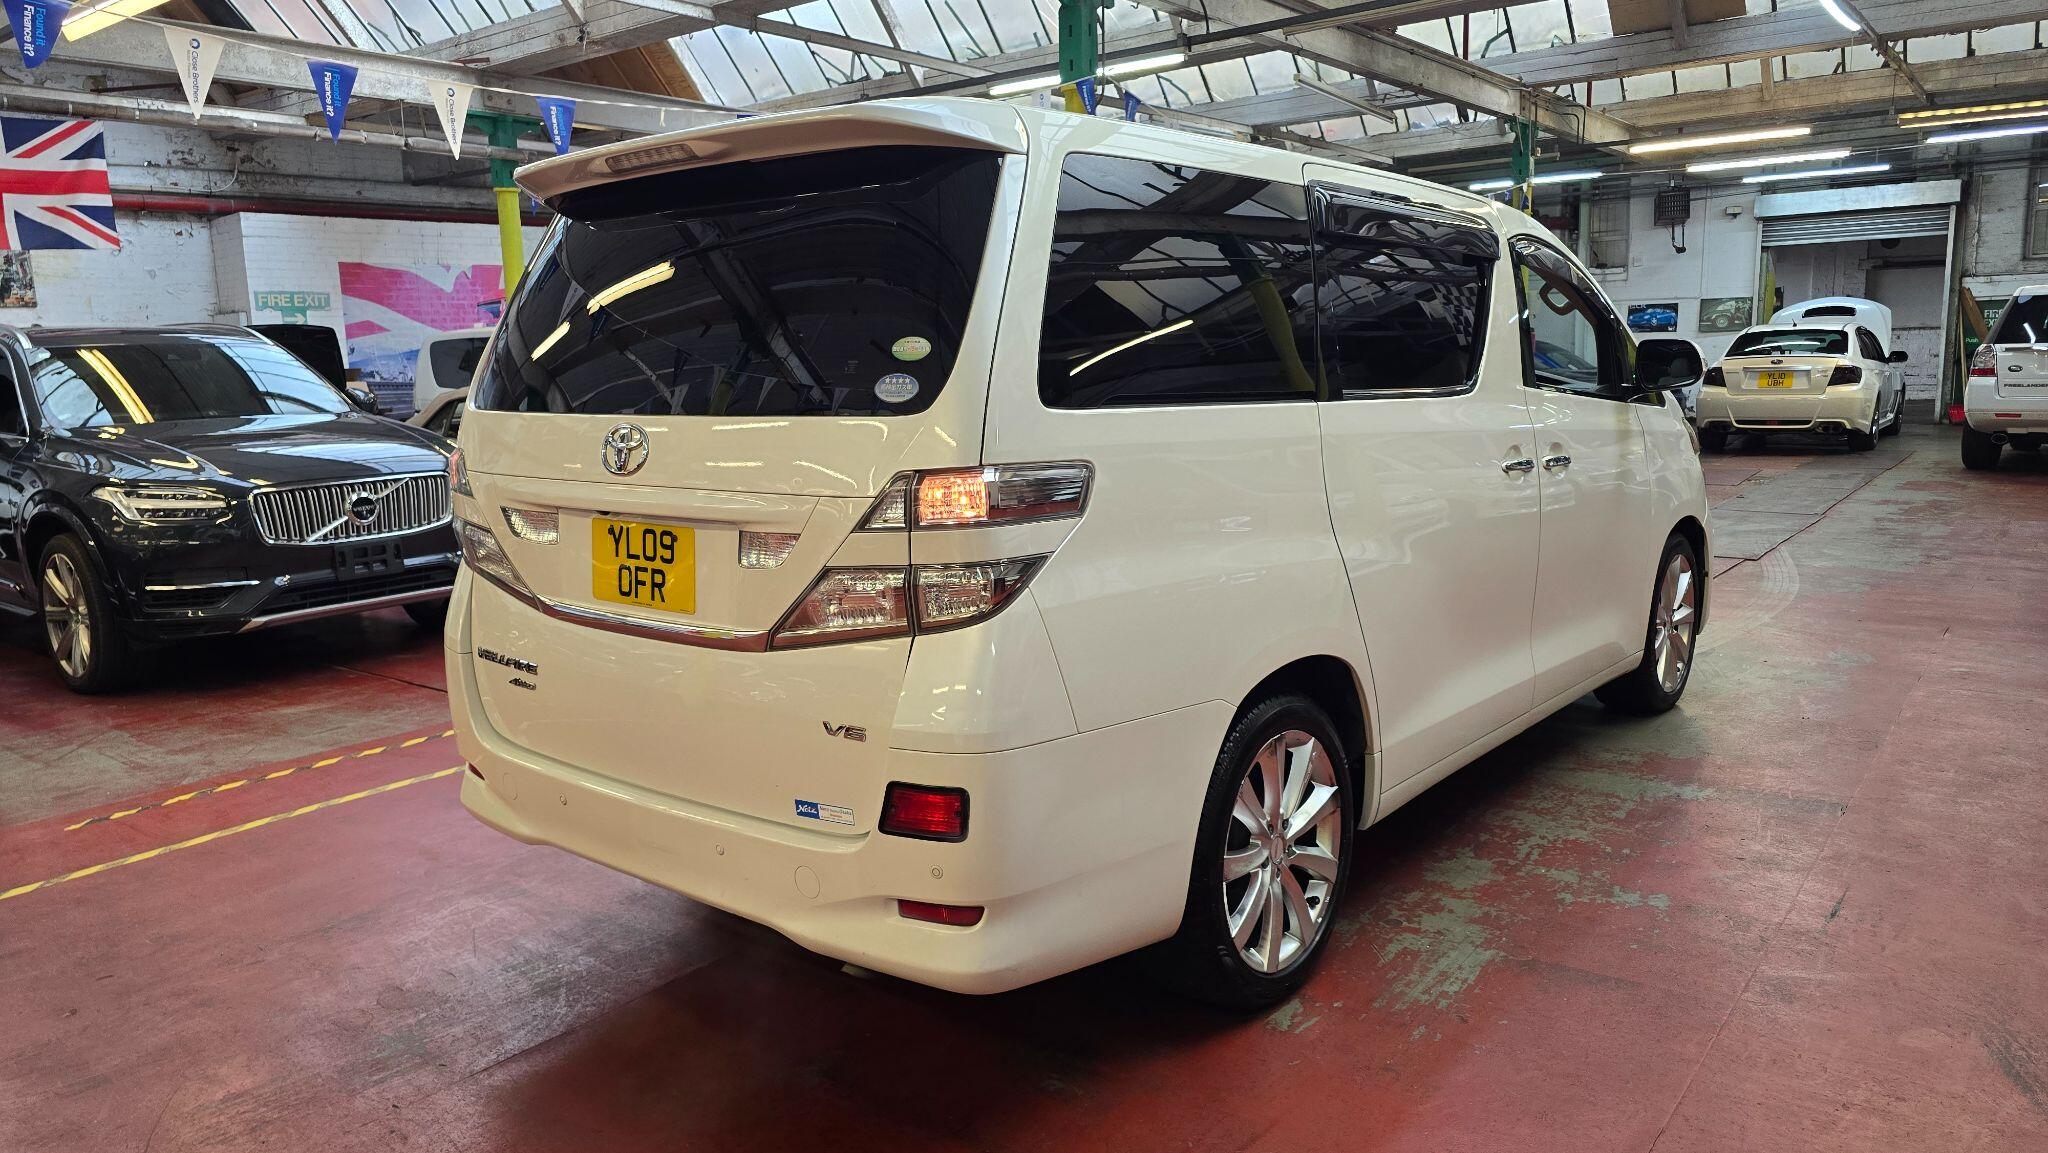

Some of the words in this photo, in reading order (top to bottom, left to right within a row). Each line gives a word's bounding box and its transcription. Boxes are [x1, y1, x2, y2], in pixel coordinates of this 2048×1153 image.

[24, 4, 34, 42] Finance
[36, 7, 46, 38] Found
[24, 43, 35, 57] it?
[191, 50, 199, 71] Close
[192, 72, 200, 103] Brothers
[324, 71, 332, 104] Finance
[332, 73, 342, 101] Found
[326, 105, 335, 117] it?
[258, 294, 292, 307] FIRE
[294, 293, 327, 307] EXIT
[1767, 372, 1786, 380] YL10
[607, 525, 675, 565] YL09
[618, 564, 666, 603] OFR
[822, 720, 867, 742] V6
